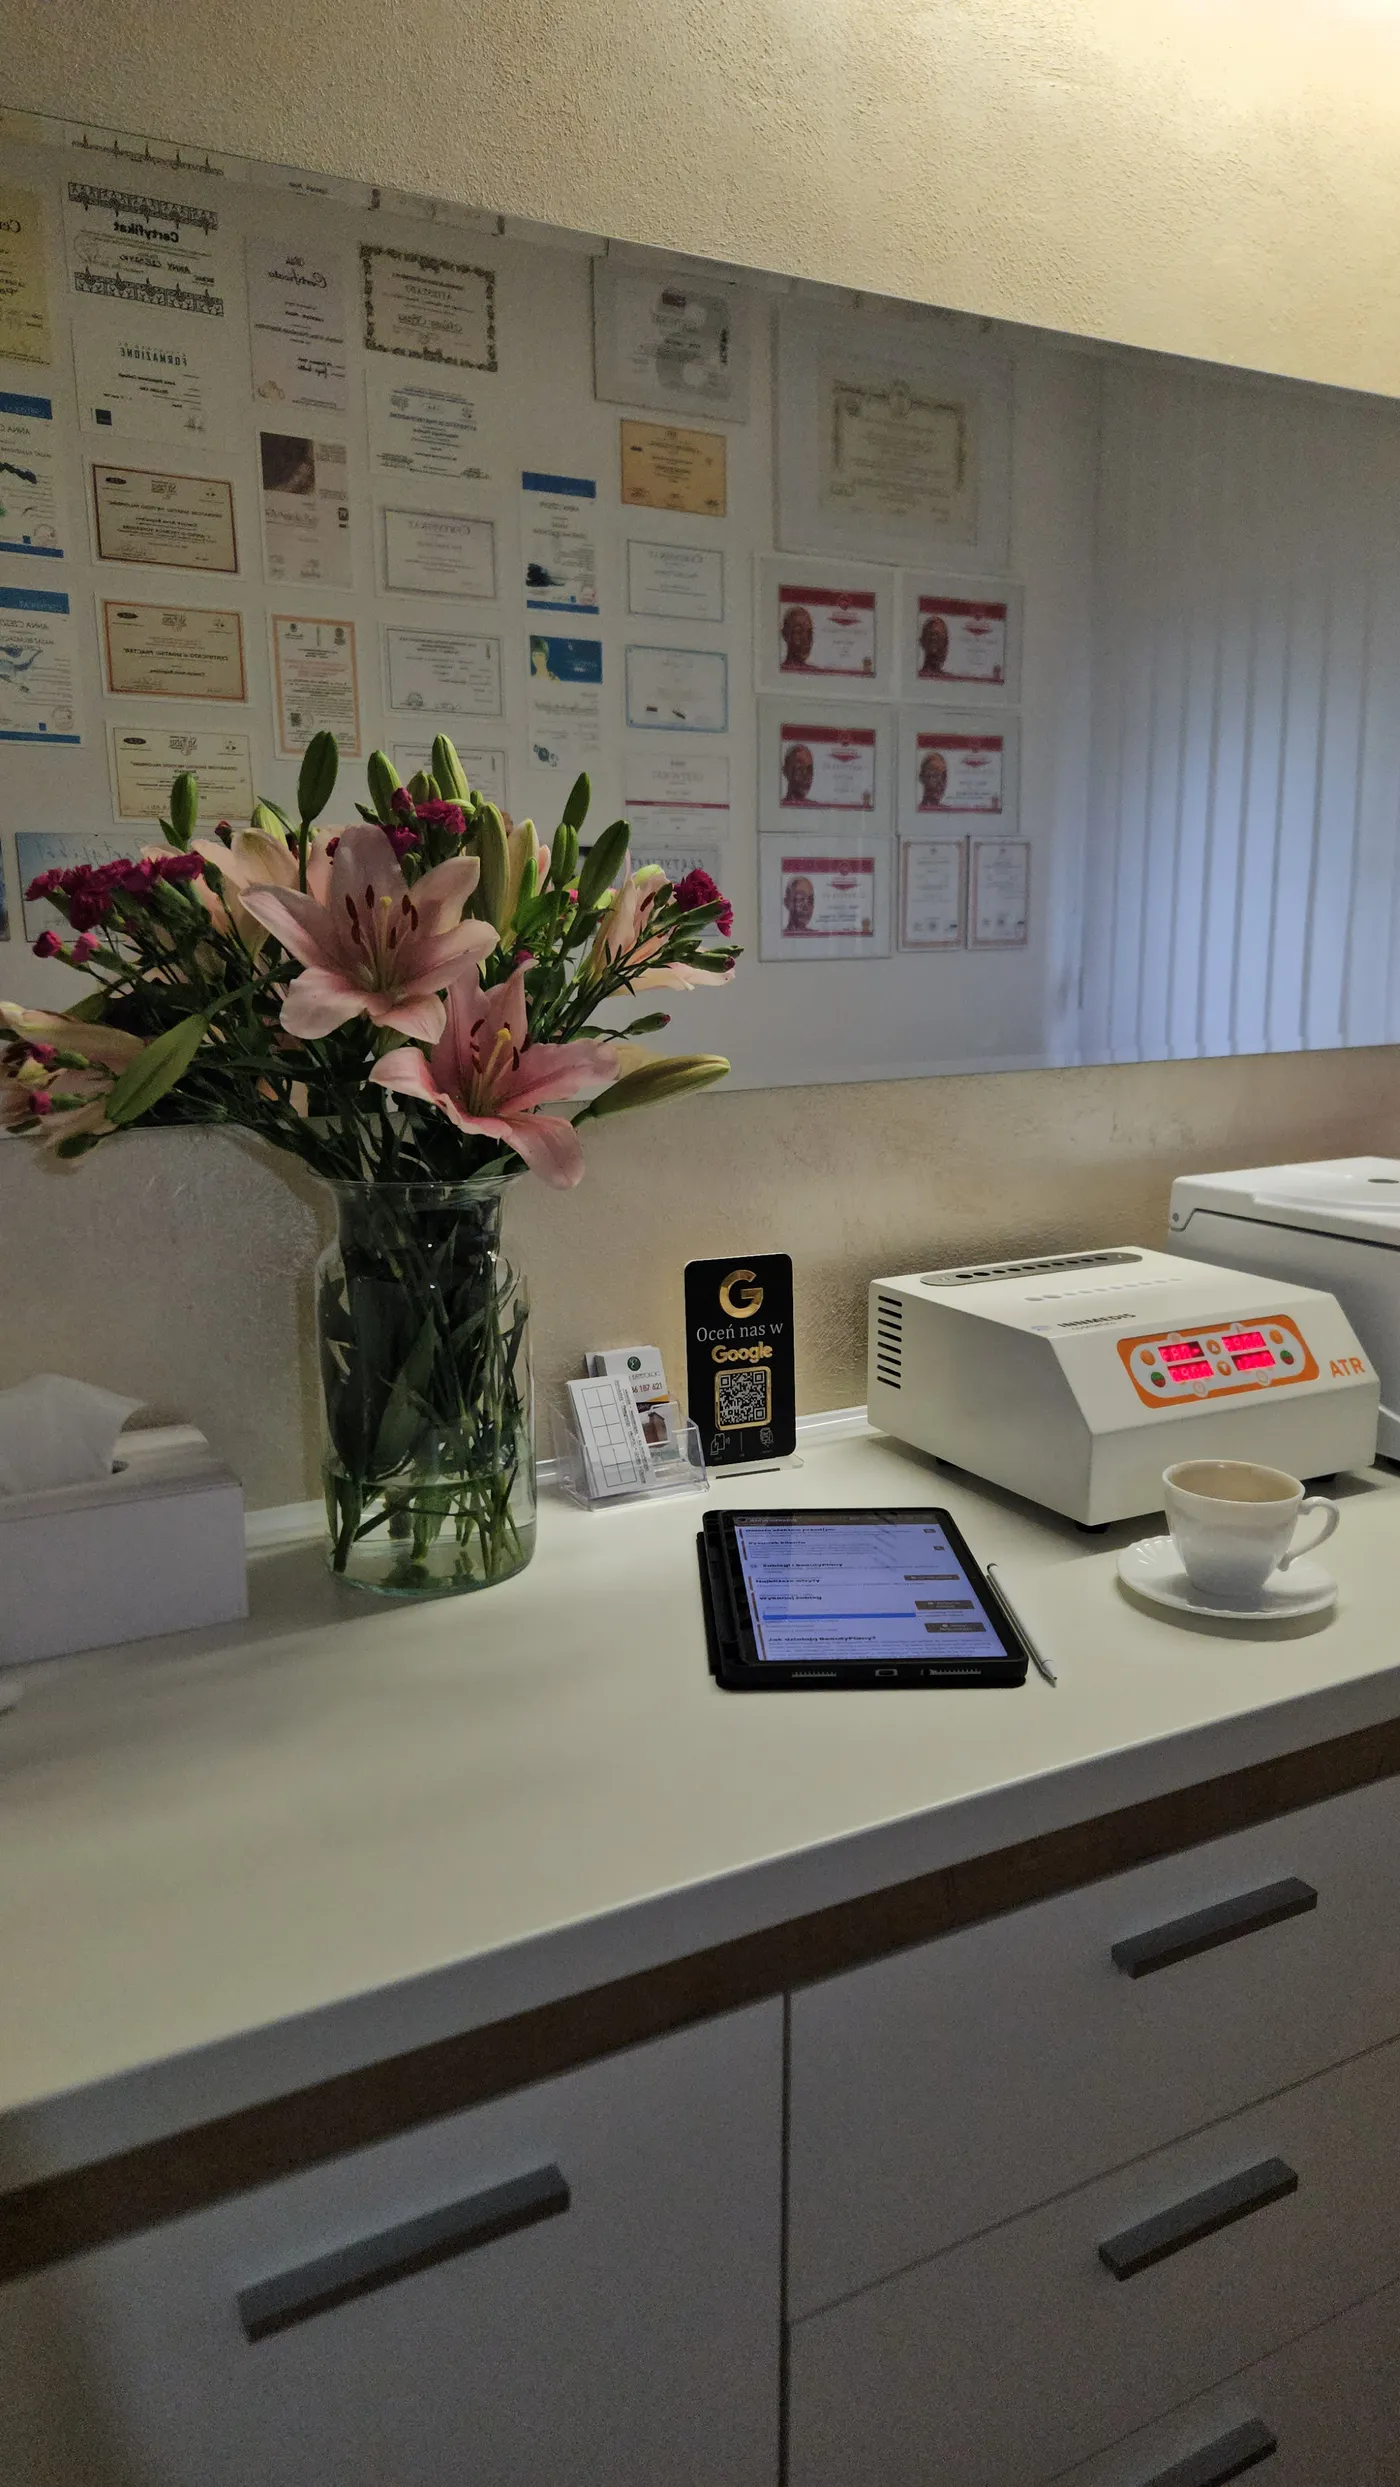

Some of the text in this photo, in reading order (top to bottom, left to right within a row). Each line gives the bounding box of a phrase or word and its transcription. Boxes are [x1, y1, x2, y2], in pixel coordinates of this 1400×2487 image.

[718, 1268, 764, 1319] G
[696, 1322, 784, 1342] Oceń nas w
[711, 1340, 773, 1364] Google
[1329, 1356, 1366, 1378] ATR
[651, 1382, 663, 1391] 621
